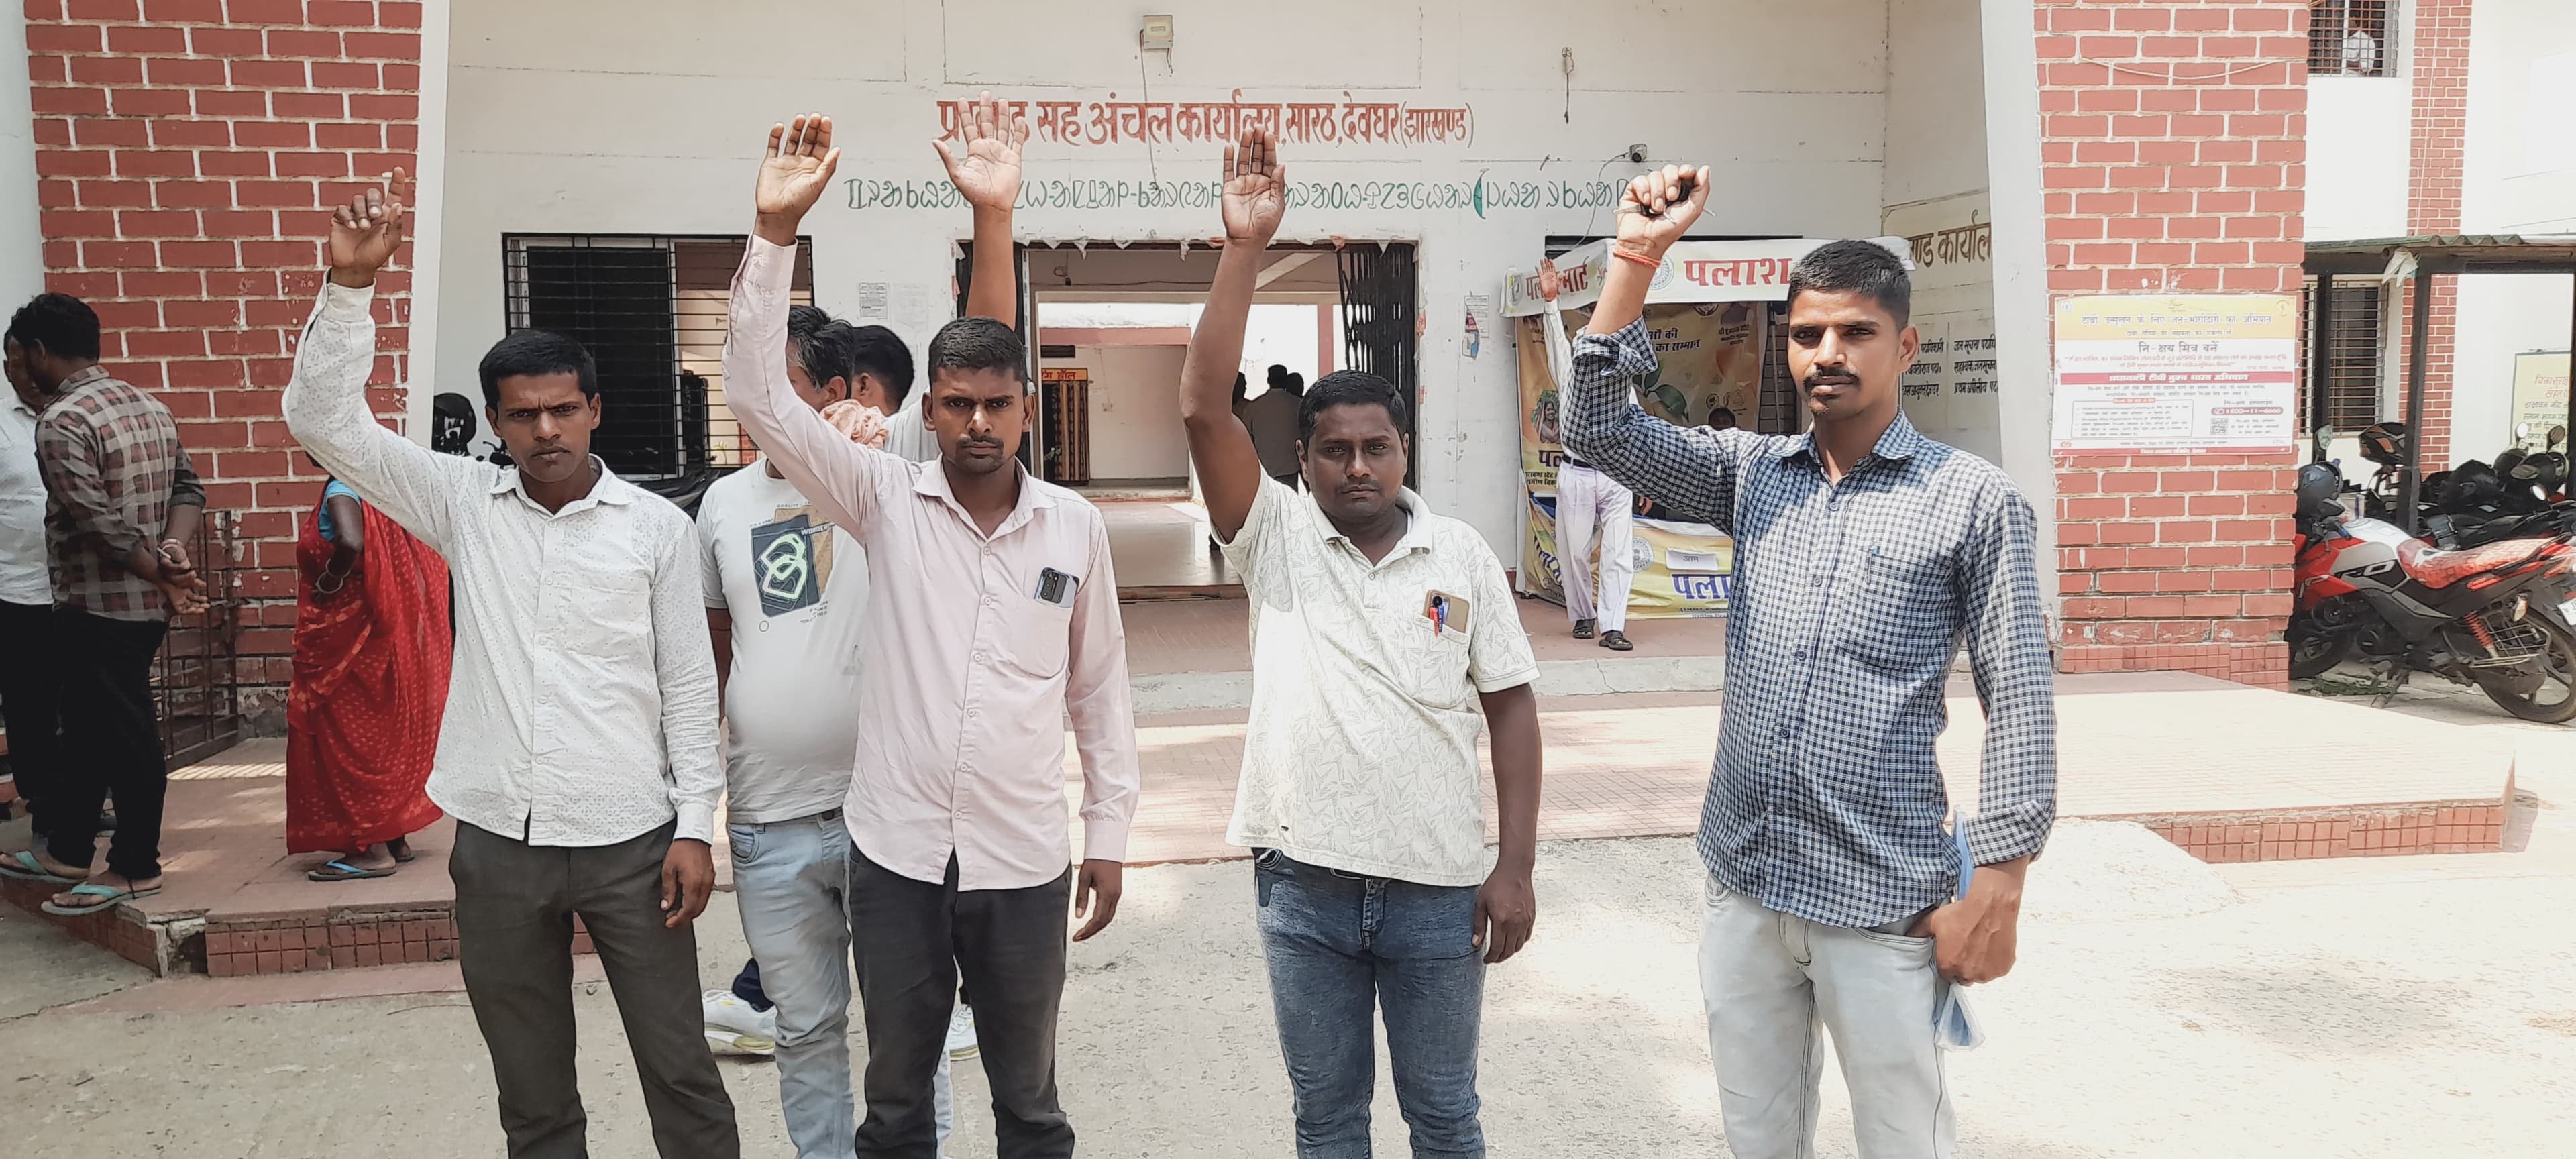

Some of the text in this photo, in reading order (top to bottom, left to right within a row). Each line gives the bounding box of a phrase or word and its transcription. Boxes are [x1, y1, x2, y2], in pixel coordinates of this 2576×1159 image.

[936, 101, 1030, 142] प्रड
[1036, 101, 1081, 146] सह
[1085, 91, 1174, 145] अंचल
[1342, 91, 1399, 145] देवघर
[1684, 258, 1793, 286] पलाश
[2178, 341, 2199, 353] मित्र
